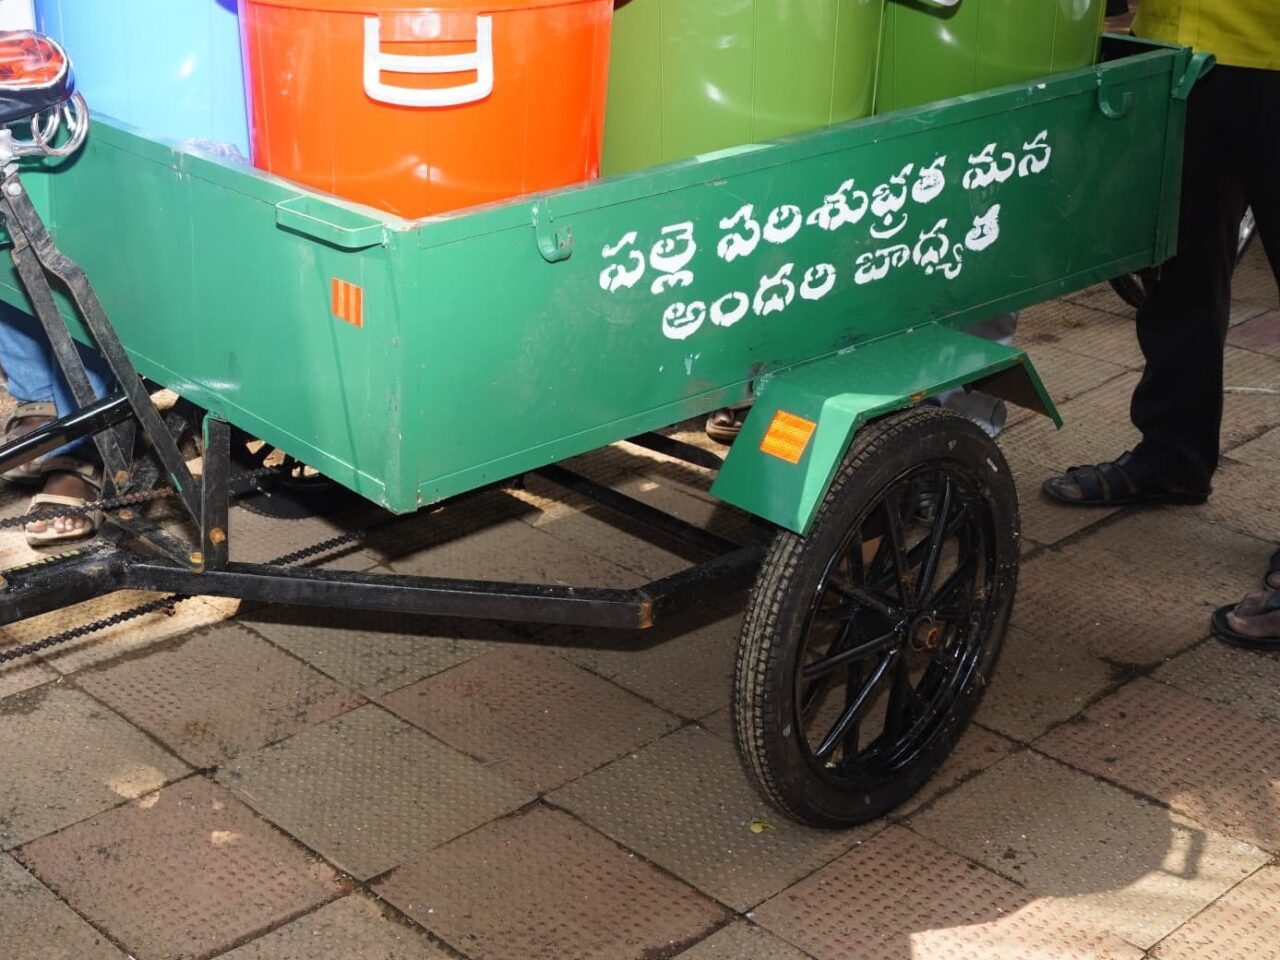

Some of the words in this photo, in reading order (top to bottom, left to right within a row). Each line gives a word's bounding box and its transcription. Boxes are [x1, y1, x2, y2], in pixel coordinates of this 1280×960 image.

[600, 222, 696, 294] పల్లె
[716, 155, 946, 261] పరిశుభ్రత
[962, 129, 1051, 189] మన
[662, 263, 836, 339] అందరి
[854, 204, 1000, 285] బాధ్యత
